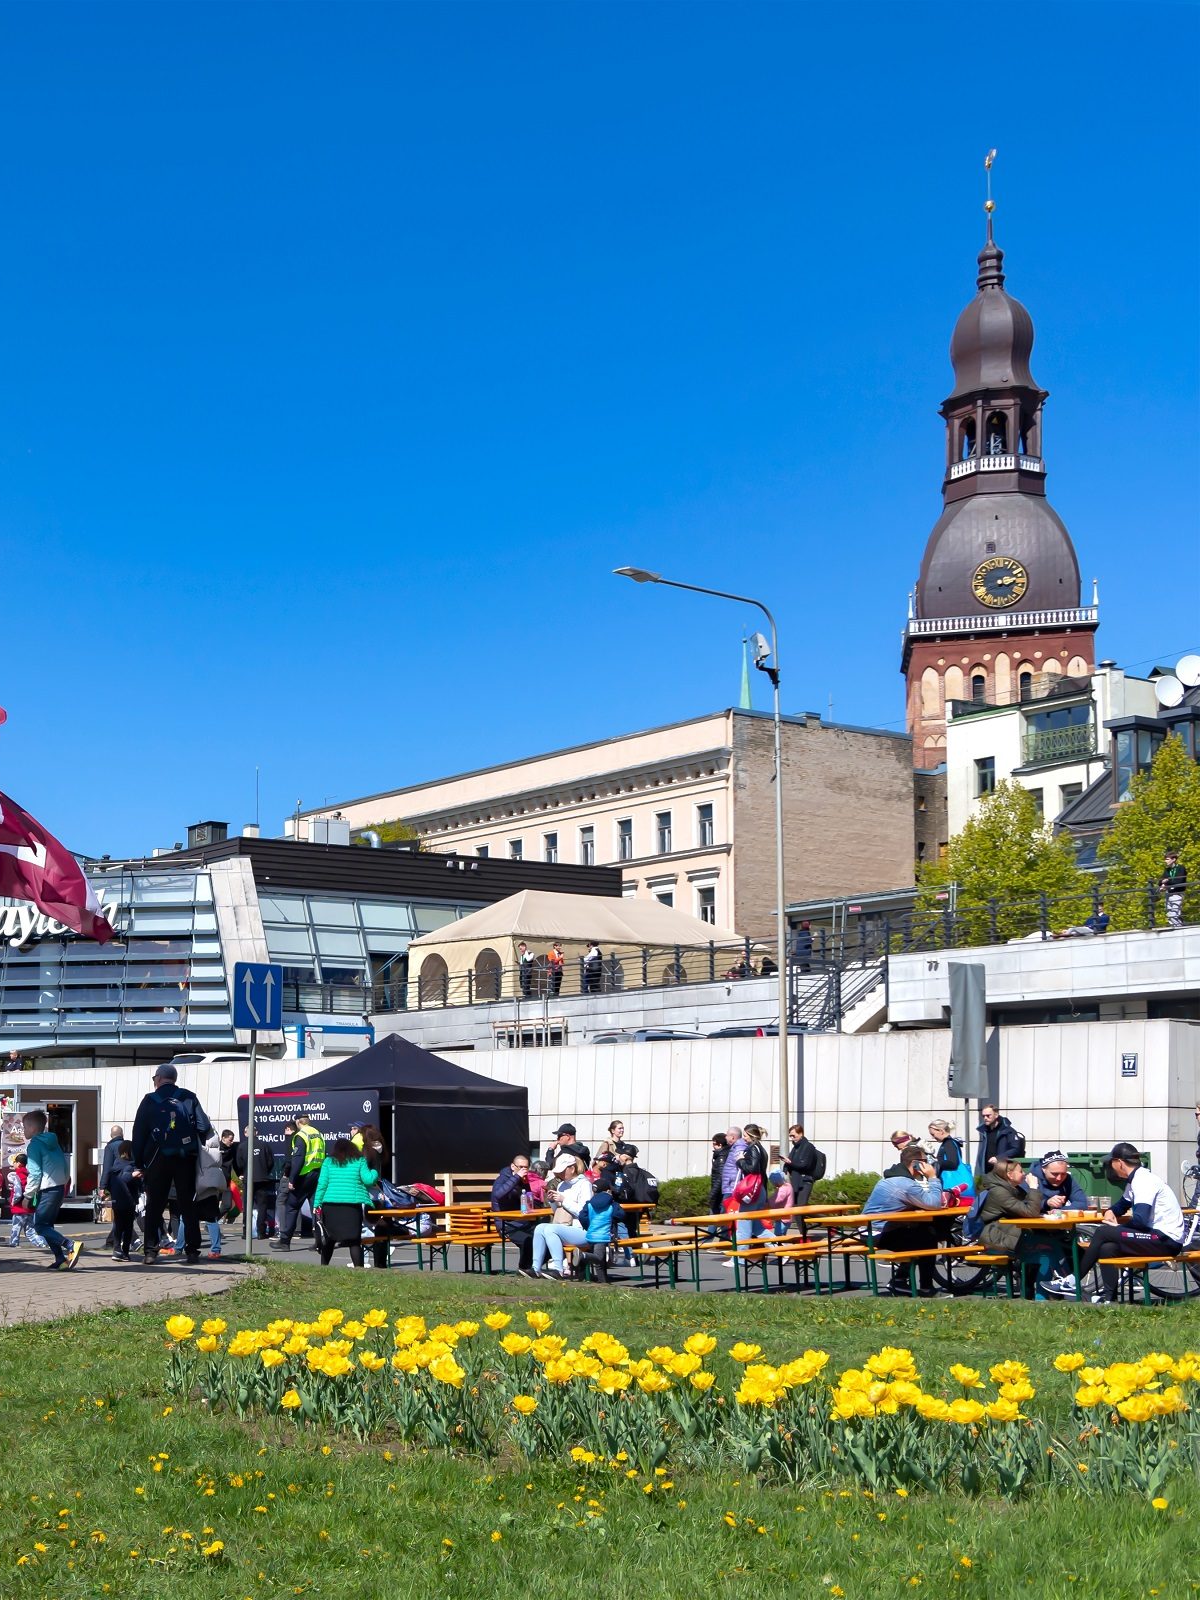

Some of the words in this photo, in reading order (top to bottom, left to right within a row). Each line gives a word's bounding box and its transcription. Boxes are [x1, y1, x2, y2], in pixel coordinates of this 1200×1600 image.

[1123, 1059, 1135, 1069] 17
[254, 1104, 272, 1112] AVAI
[273, 1103, 302, 1112] TOYOTA
[303, 1102, 326, 1111] TAGAD
[268, 1114, 291, 1122] GADU
